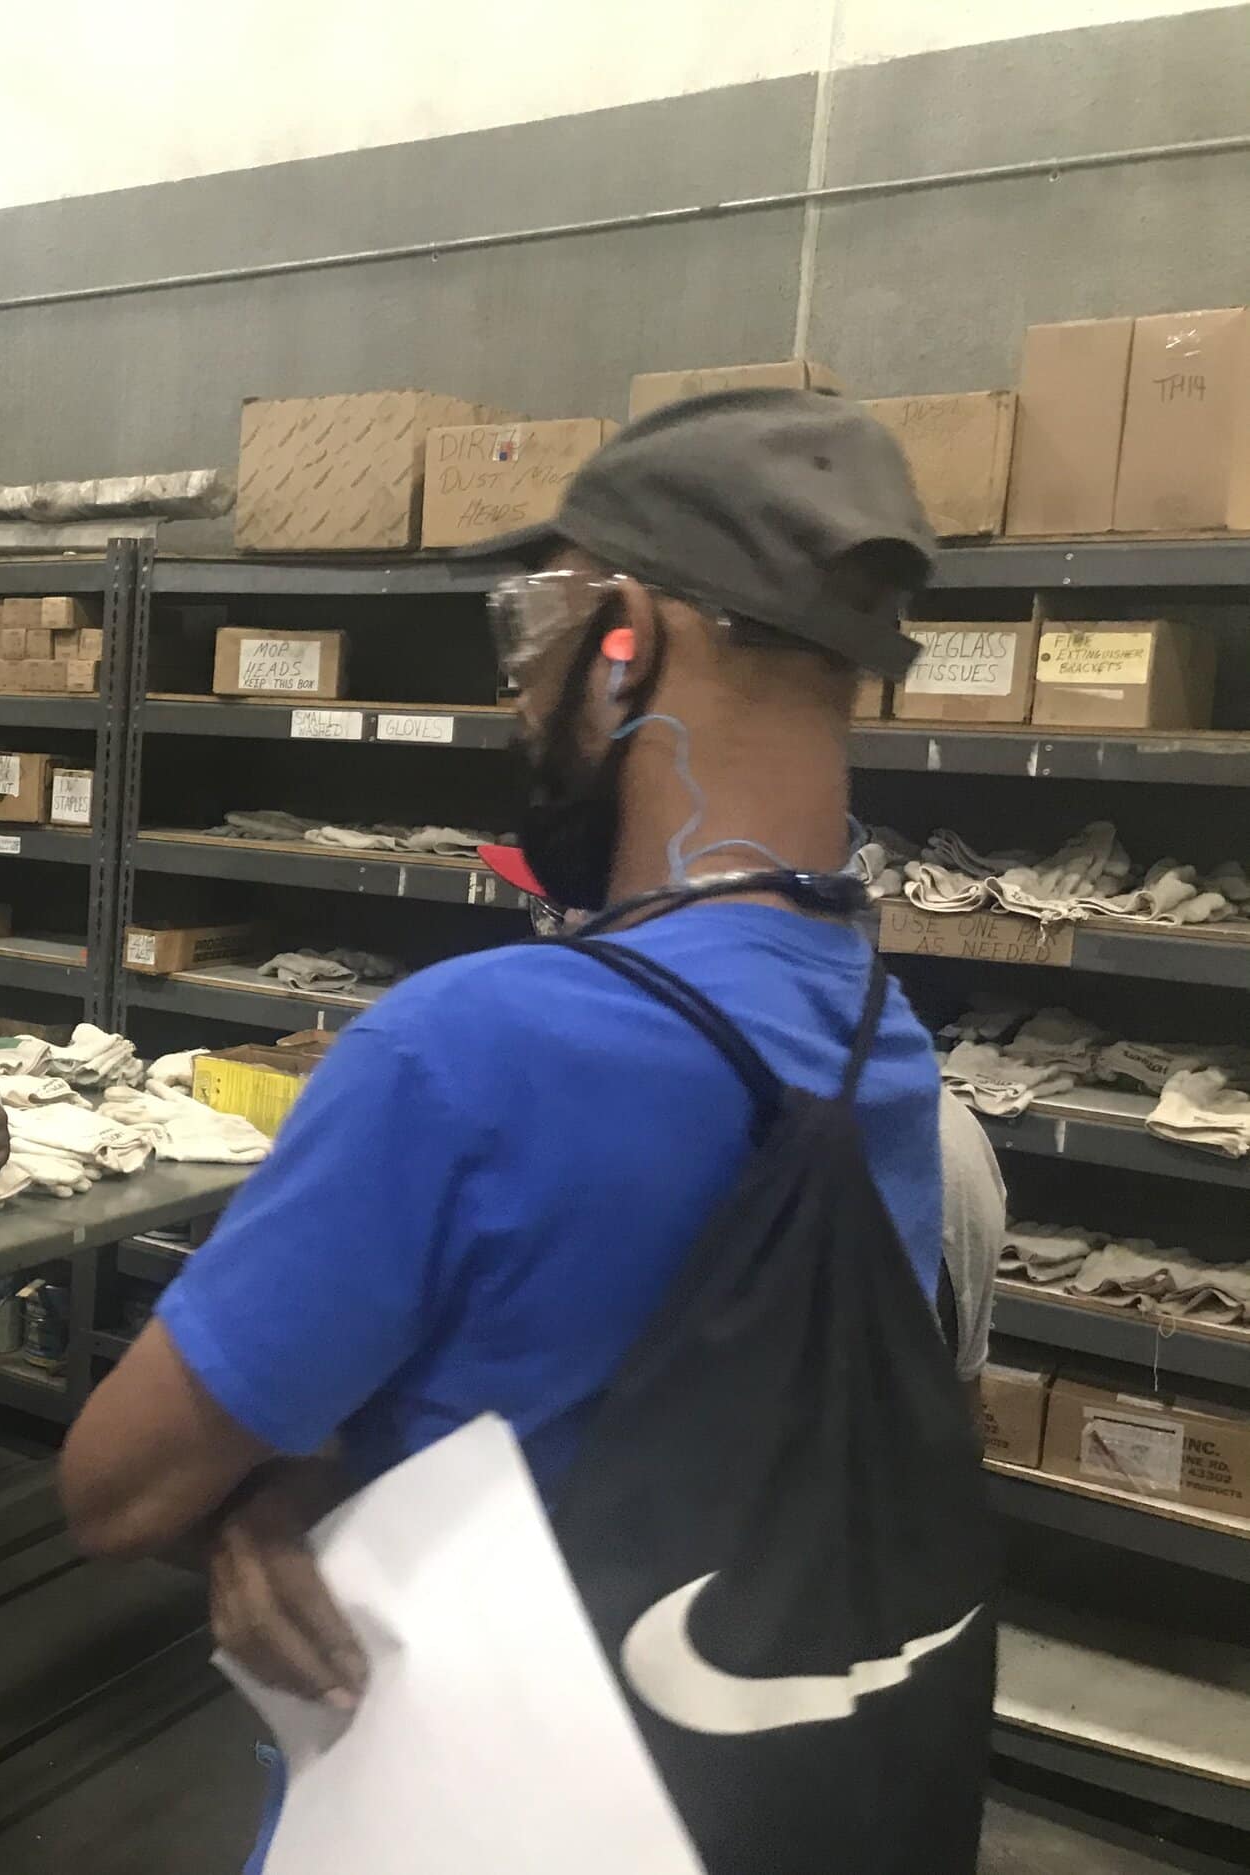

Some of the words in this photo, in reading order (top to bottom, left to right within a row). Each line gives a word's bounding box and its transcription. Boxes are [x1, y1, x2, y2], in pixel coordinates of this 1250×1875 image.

[439, 466, 502, 495] DUST
[253, 642, 290, 657] MOP
[1056, 648, 1144, 661] EXTINGUISHER
[243, 661, 302, 680] HEADS
[911, 663, 999, 683] TISSUES
[1059, 661, 1124, 674] BRACKETS
[385, 718, 443, 739] GLOVES
[892, 912, 938, 935] USE
[958, 914, 1000, 939] ONE
[915, 936, 944, 954] AS
[960, 940, 1051, 963] NEEDED
[1182, 1436, 1221, 1457] INC.
